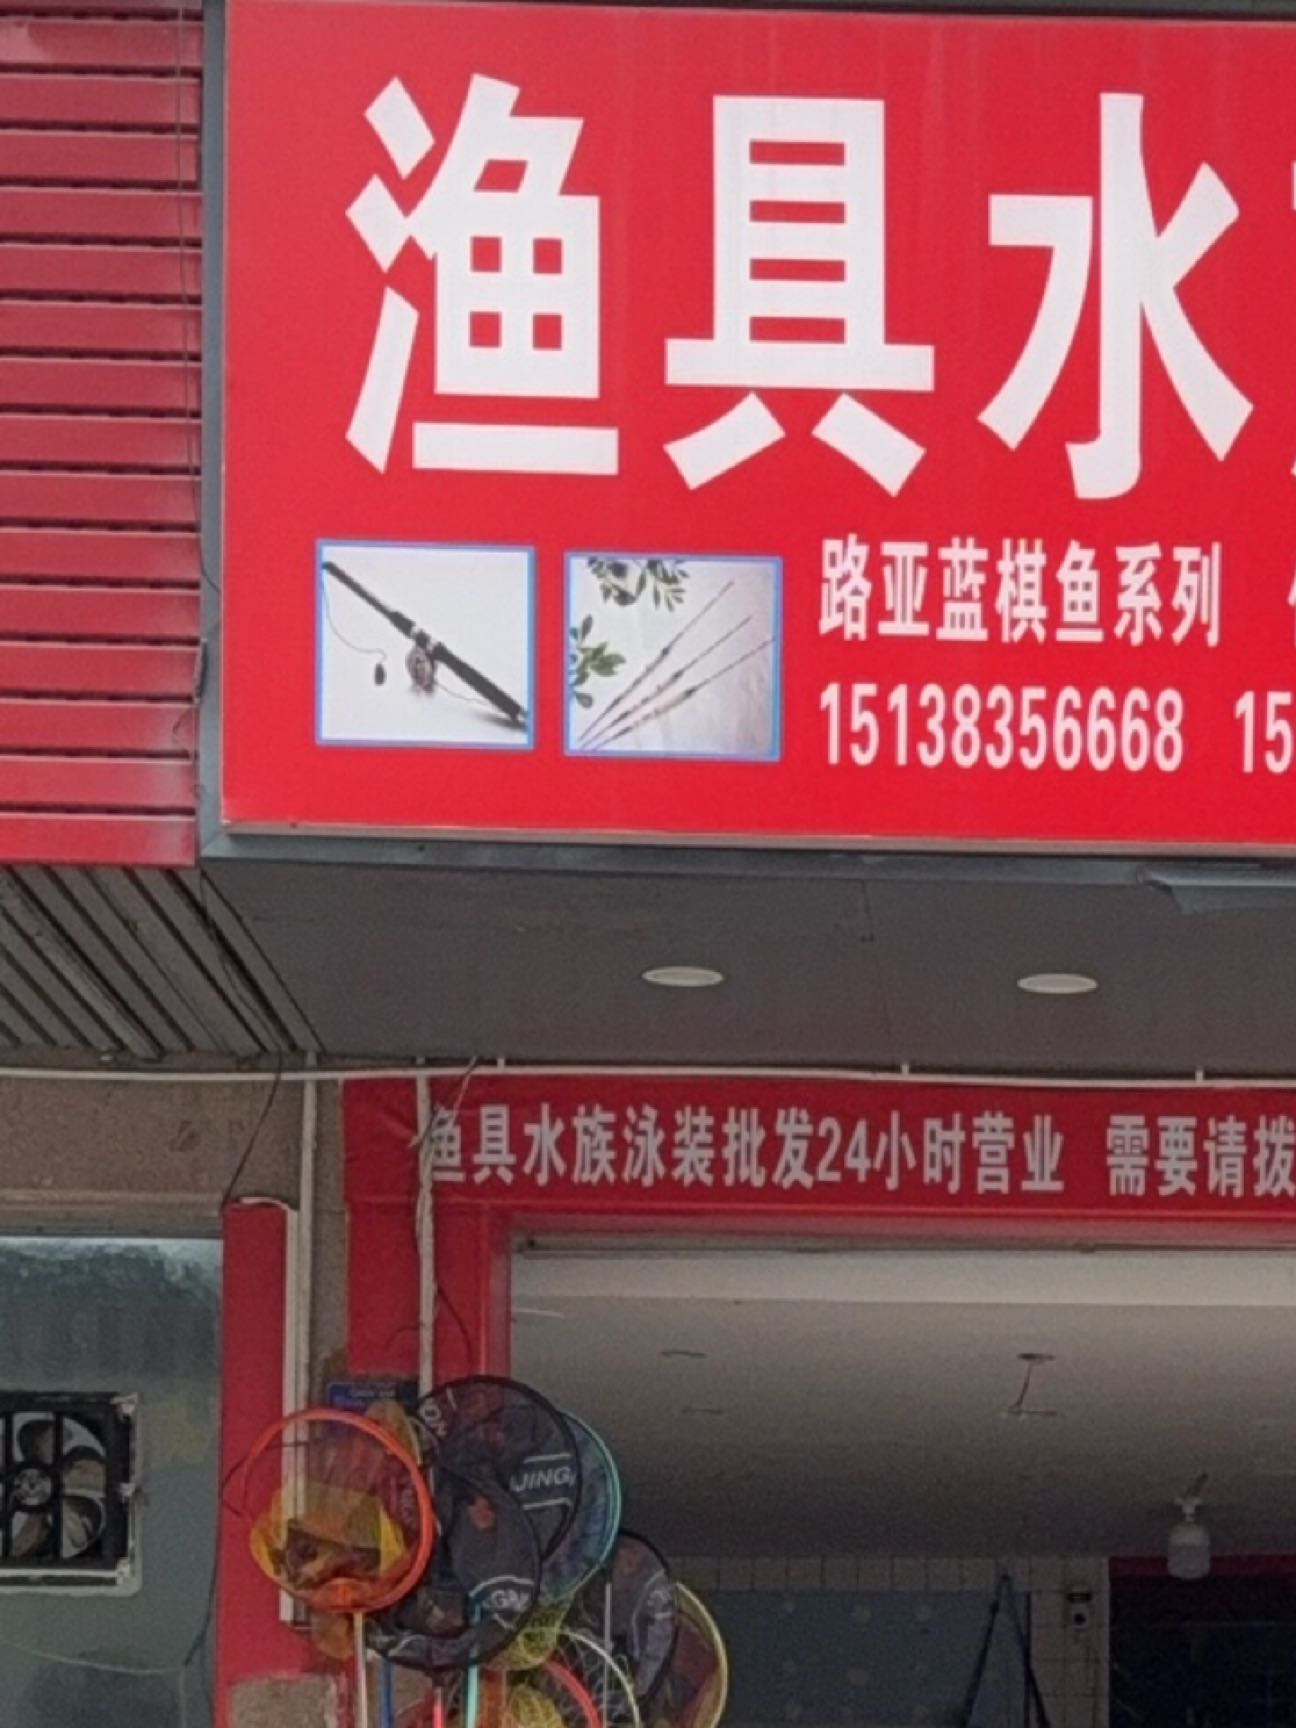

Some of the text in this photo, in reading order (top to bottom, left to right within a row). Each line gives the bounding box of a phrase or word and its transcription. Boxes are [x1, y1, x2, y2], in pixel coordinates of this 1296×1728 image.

[819, 534, 1221, 647] 路亚蓝棋鱼系列
[819, 682, 1184, 773] 15138356668
